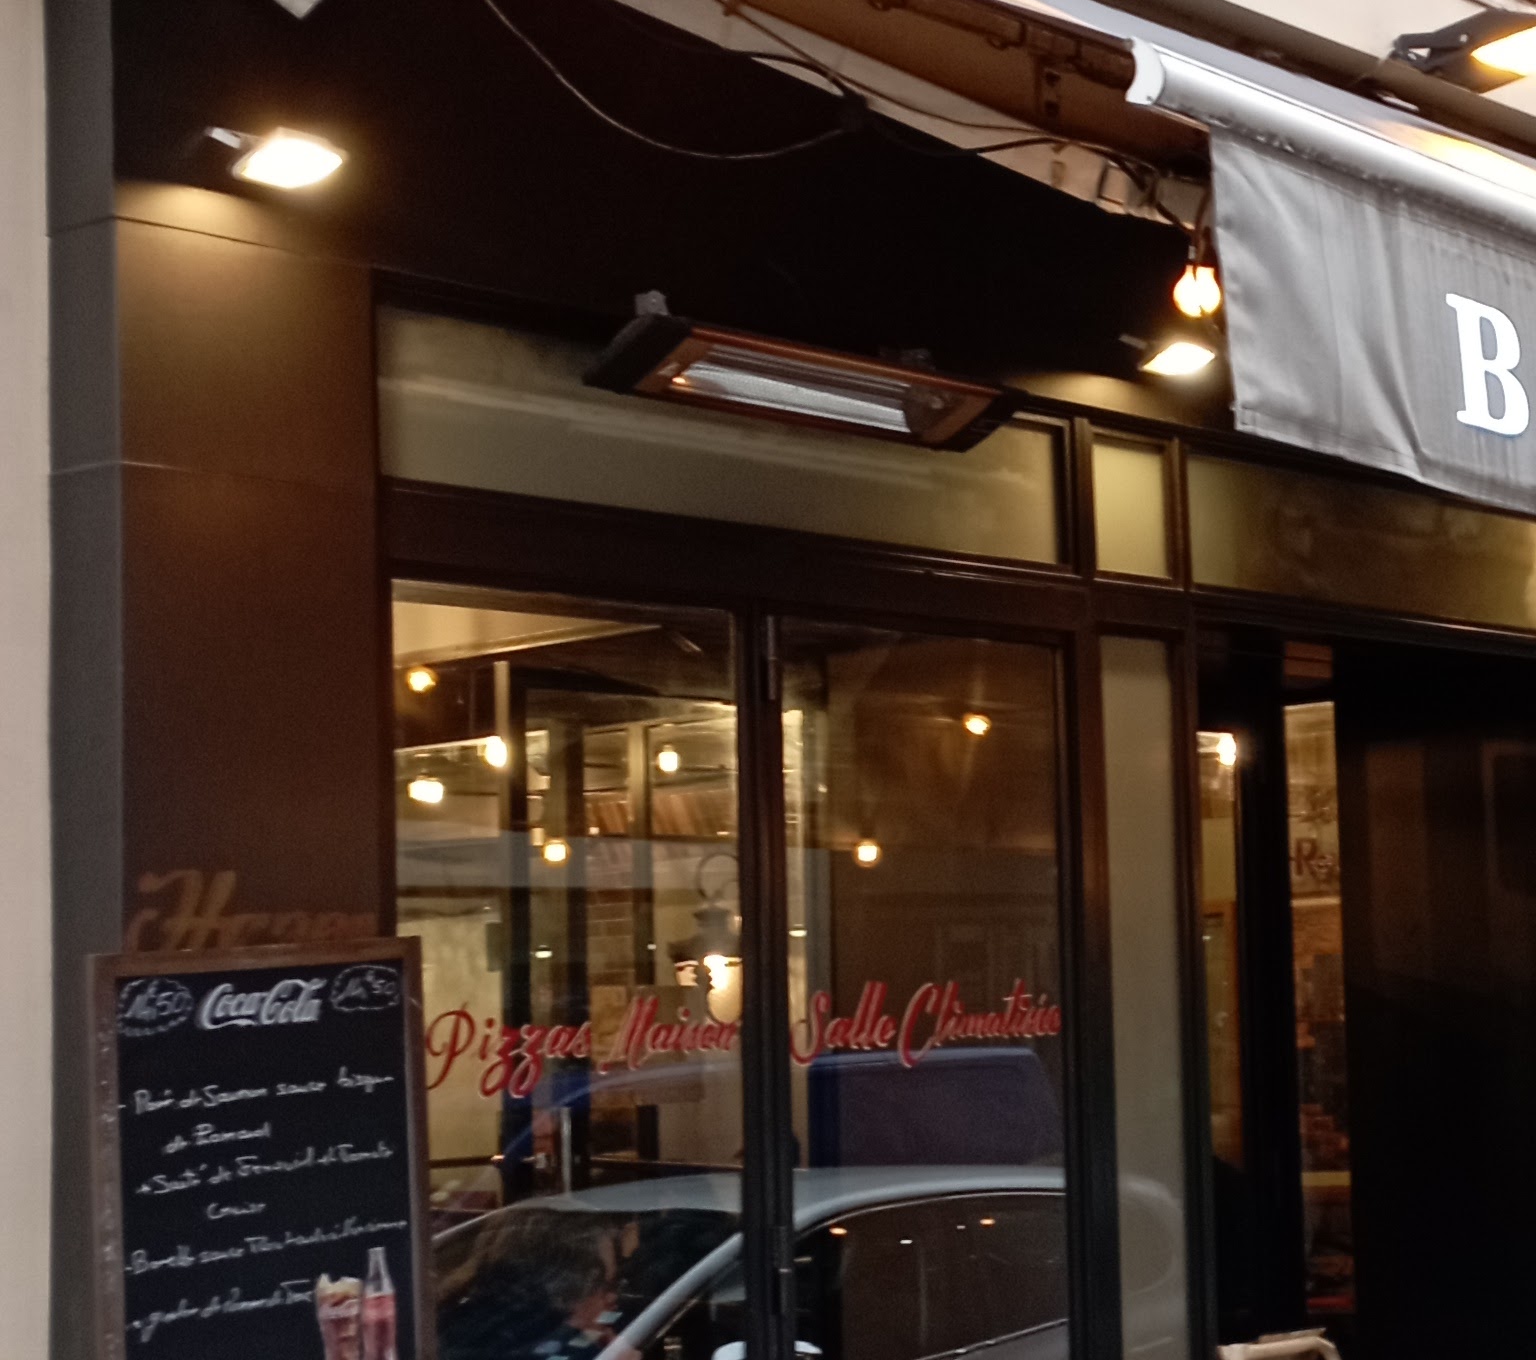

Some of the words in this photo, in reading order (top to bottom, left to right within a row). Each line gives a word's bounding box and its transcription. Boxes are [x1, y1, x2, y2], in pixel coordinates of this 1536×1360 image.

[426, 1002, 592, 1099] Pizzas
[598, 995, 739, 1075] Maison
[790, 980, 898, 1066] Salle
